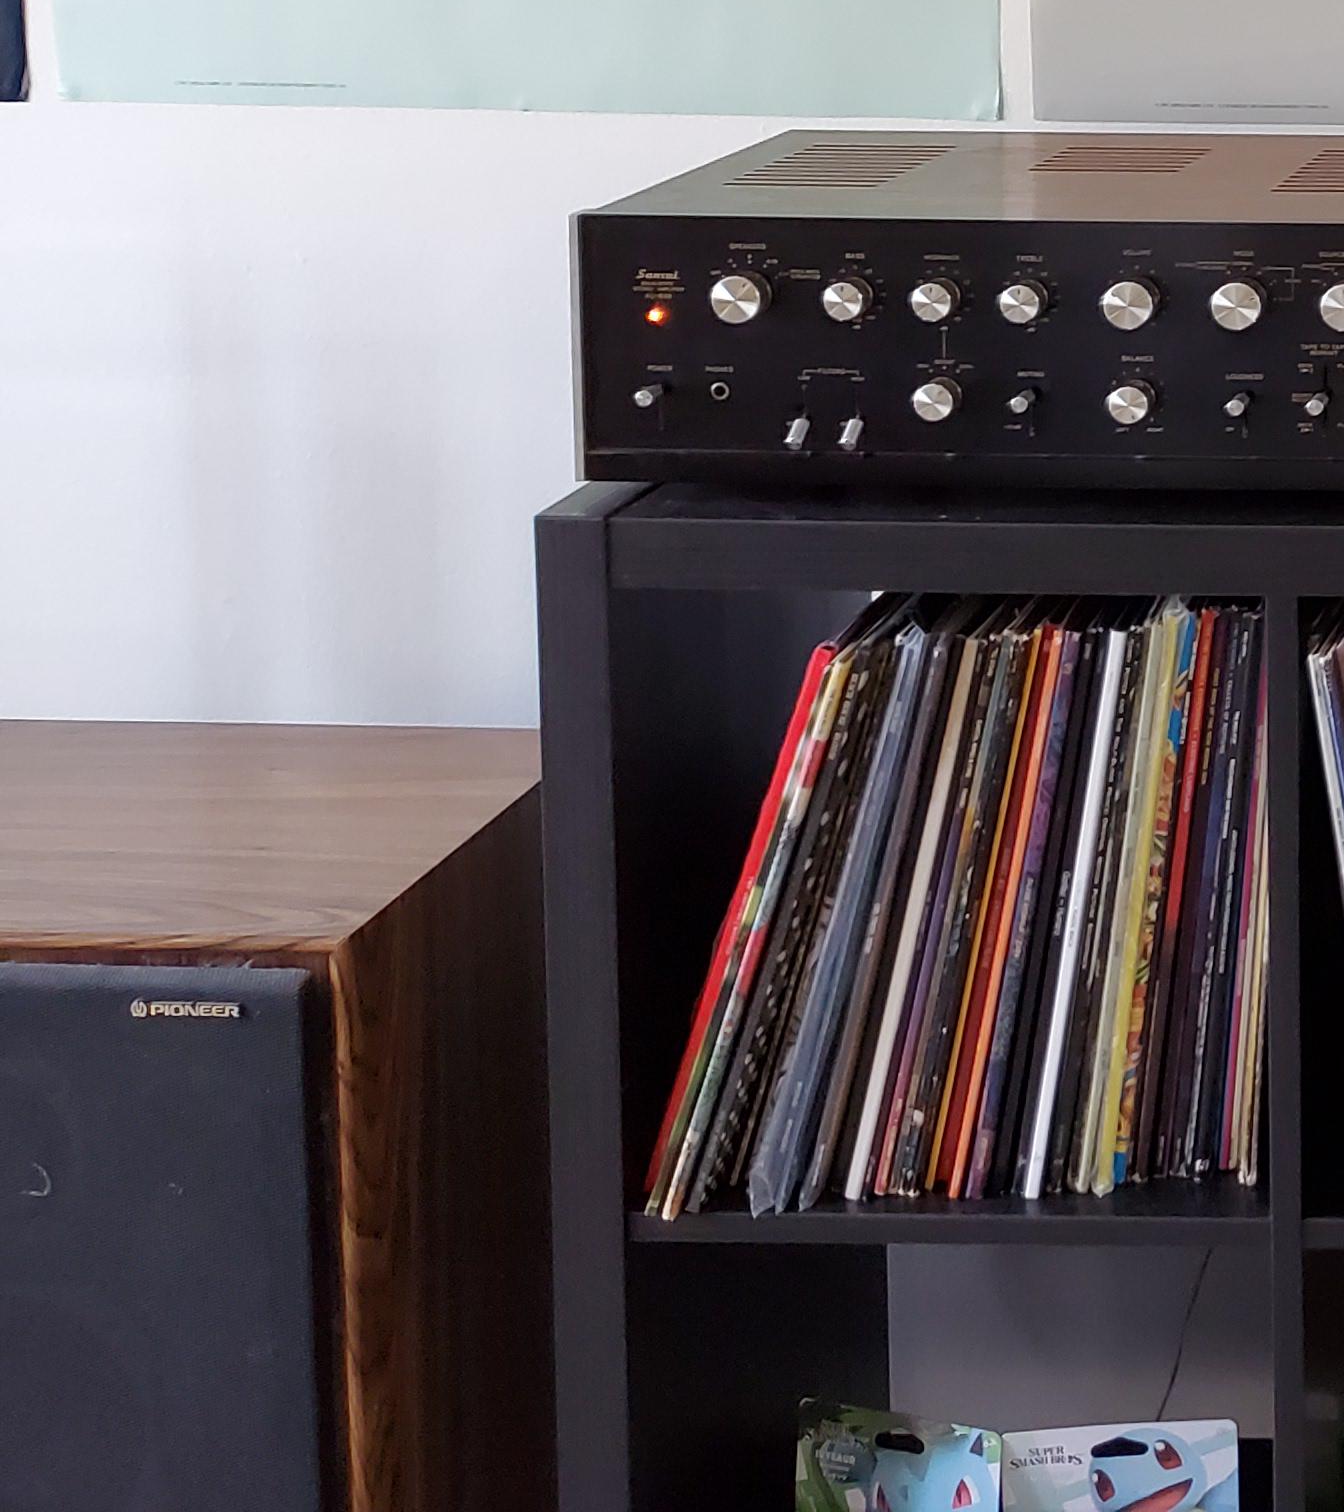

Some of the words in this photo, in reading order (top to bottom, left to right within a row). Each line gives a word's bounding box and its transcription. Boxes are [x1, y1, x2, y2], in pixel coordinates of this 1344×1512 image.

[150, 1001, 240, 1018] PIONEER
[1028, 1446, 1065, 1457] SUPER
[1009, 1455, 1049, 1468] SMASH
